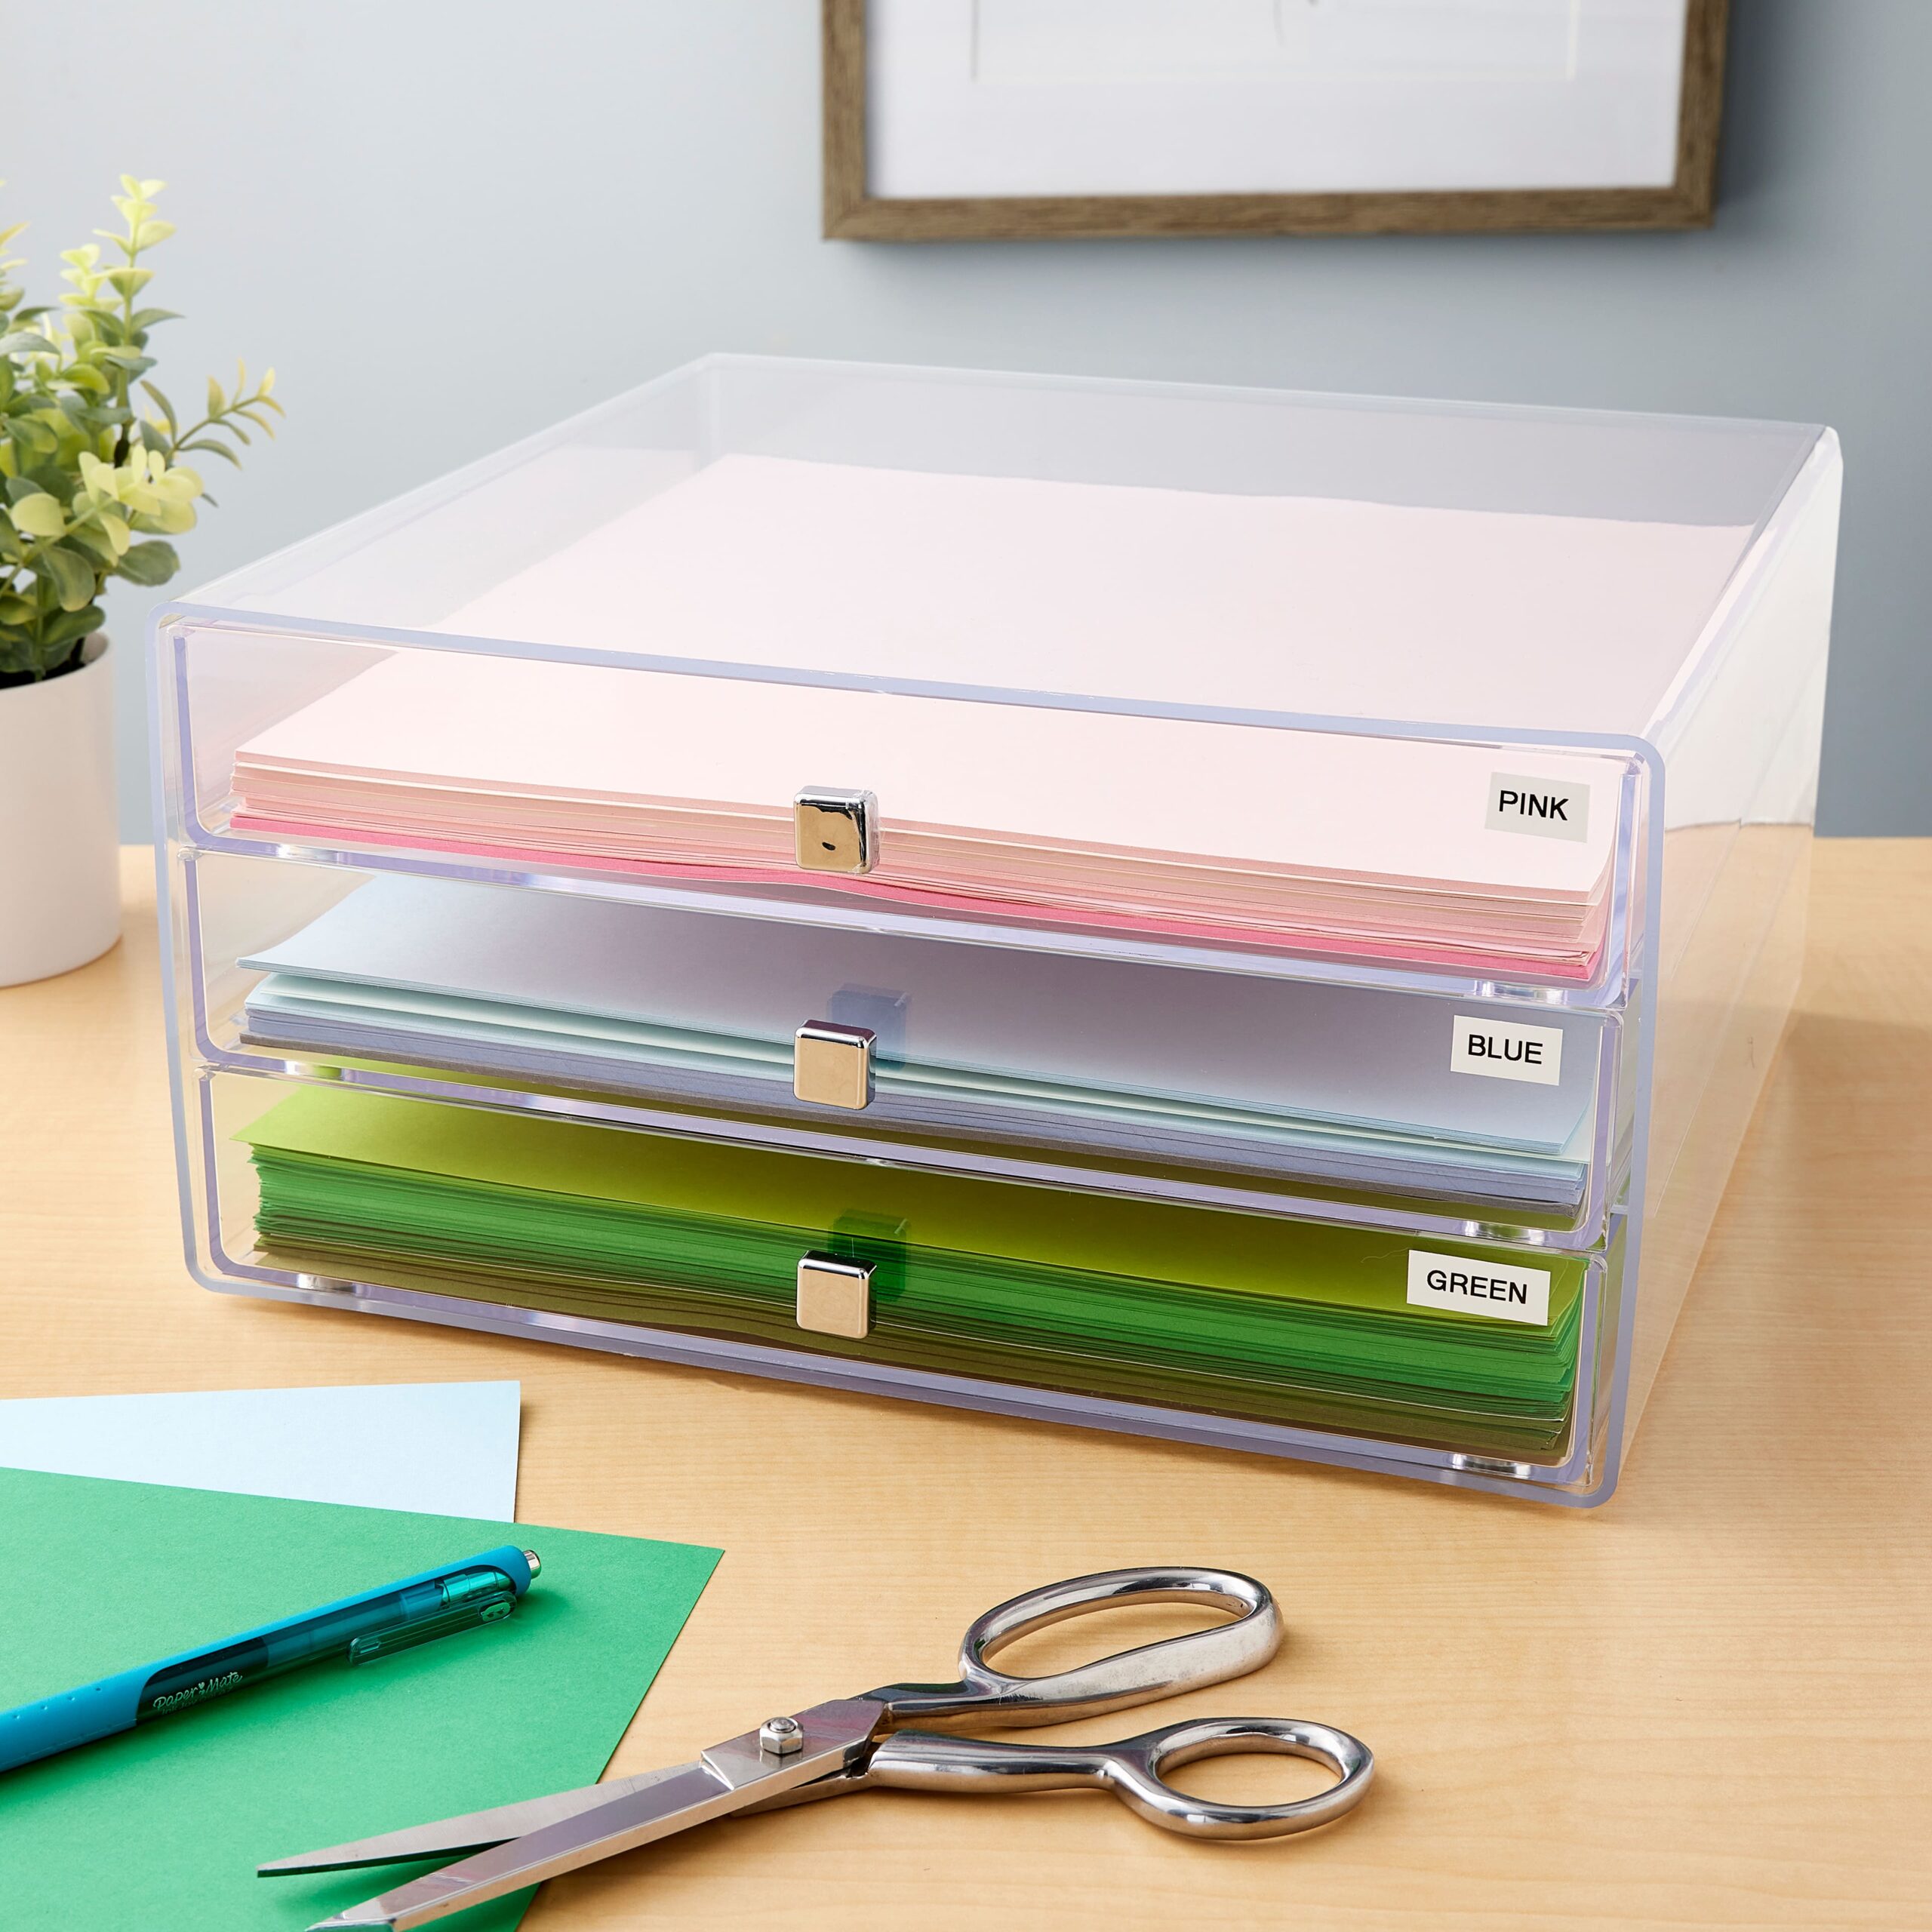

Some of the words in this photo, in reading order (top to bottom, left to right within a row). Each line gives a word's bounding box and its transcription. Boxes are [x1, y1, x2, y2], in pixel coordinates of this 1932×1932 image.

[1499, 789, 1569, 821] PINK
[1468, 1034, 1543, 1065] BLUE
[1426, 1269, 1527, 1305] GREEN
[153, 1687, 198, 1710] Paper
[205, 1672, 243, 1693] Mate
